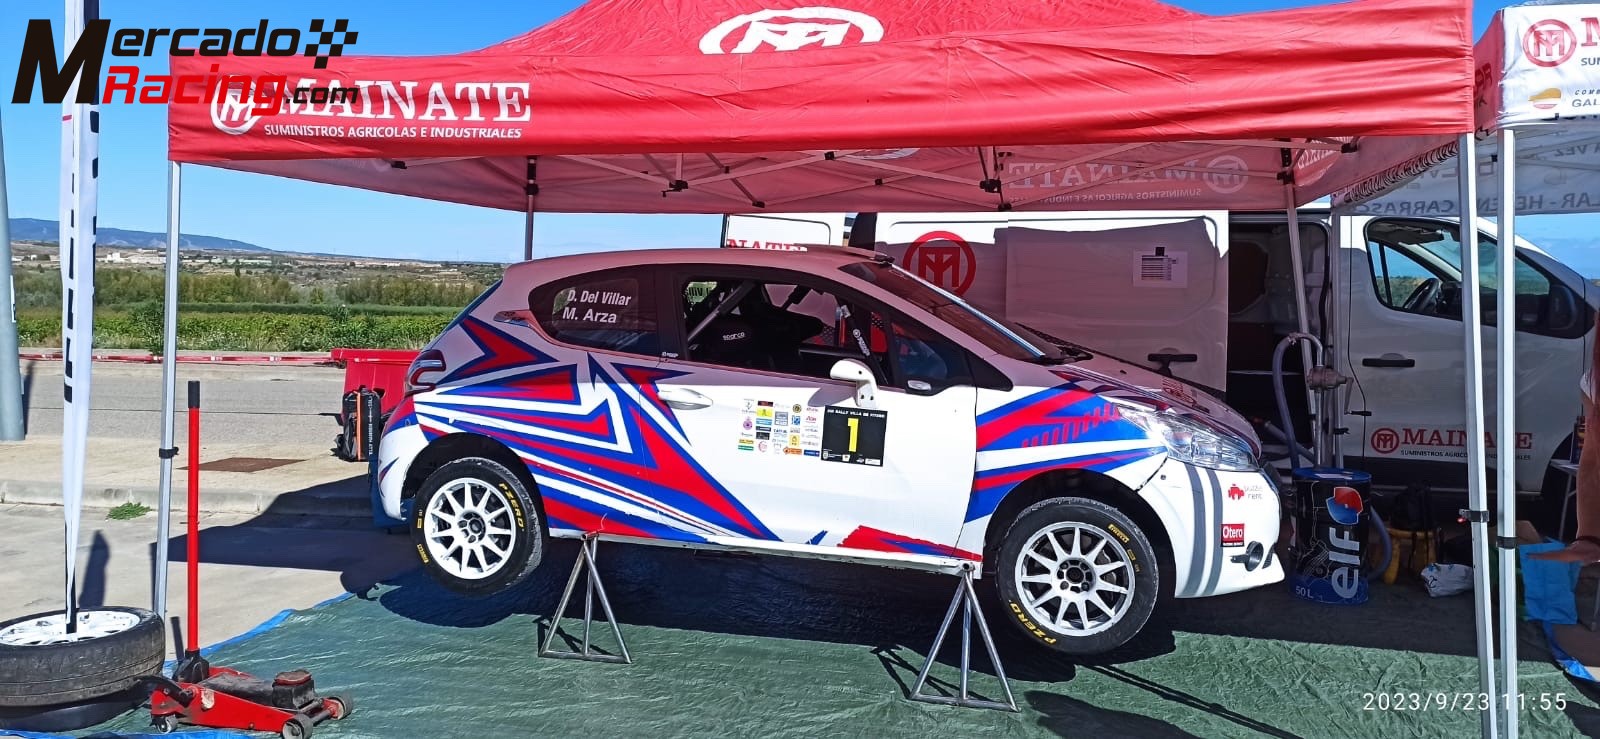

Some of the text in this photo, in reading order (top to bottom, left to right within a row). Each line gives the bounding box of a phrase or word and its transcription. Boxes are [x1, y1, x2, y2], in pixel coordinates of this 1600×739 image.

[274, 78, 531, 122] MAINATE
[264, 123, 521, 139] SUMINISTROS AGRICOLAS E INDUSTRIALES
[567, 289, 631, 306] D. Del Villar
[562, 307, 617, 324] M. Arza
[848, 418, 859, 452] 1
[1401, 449, 1443, 457] SUMINISTROS
[1223, 526, 1243, 539] Otero
[1328, 526, 1361, 599] elf
